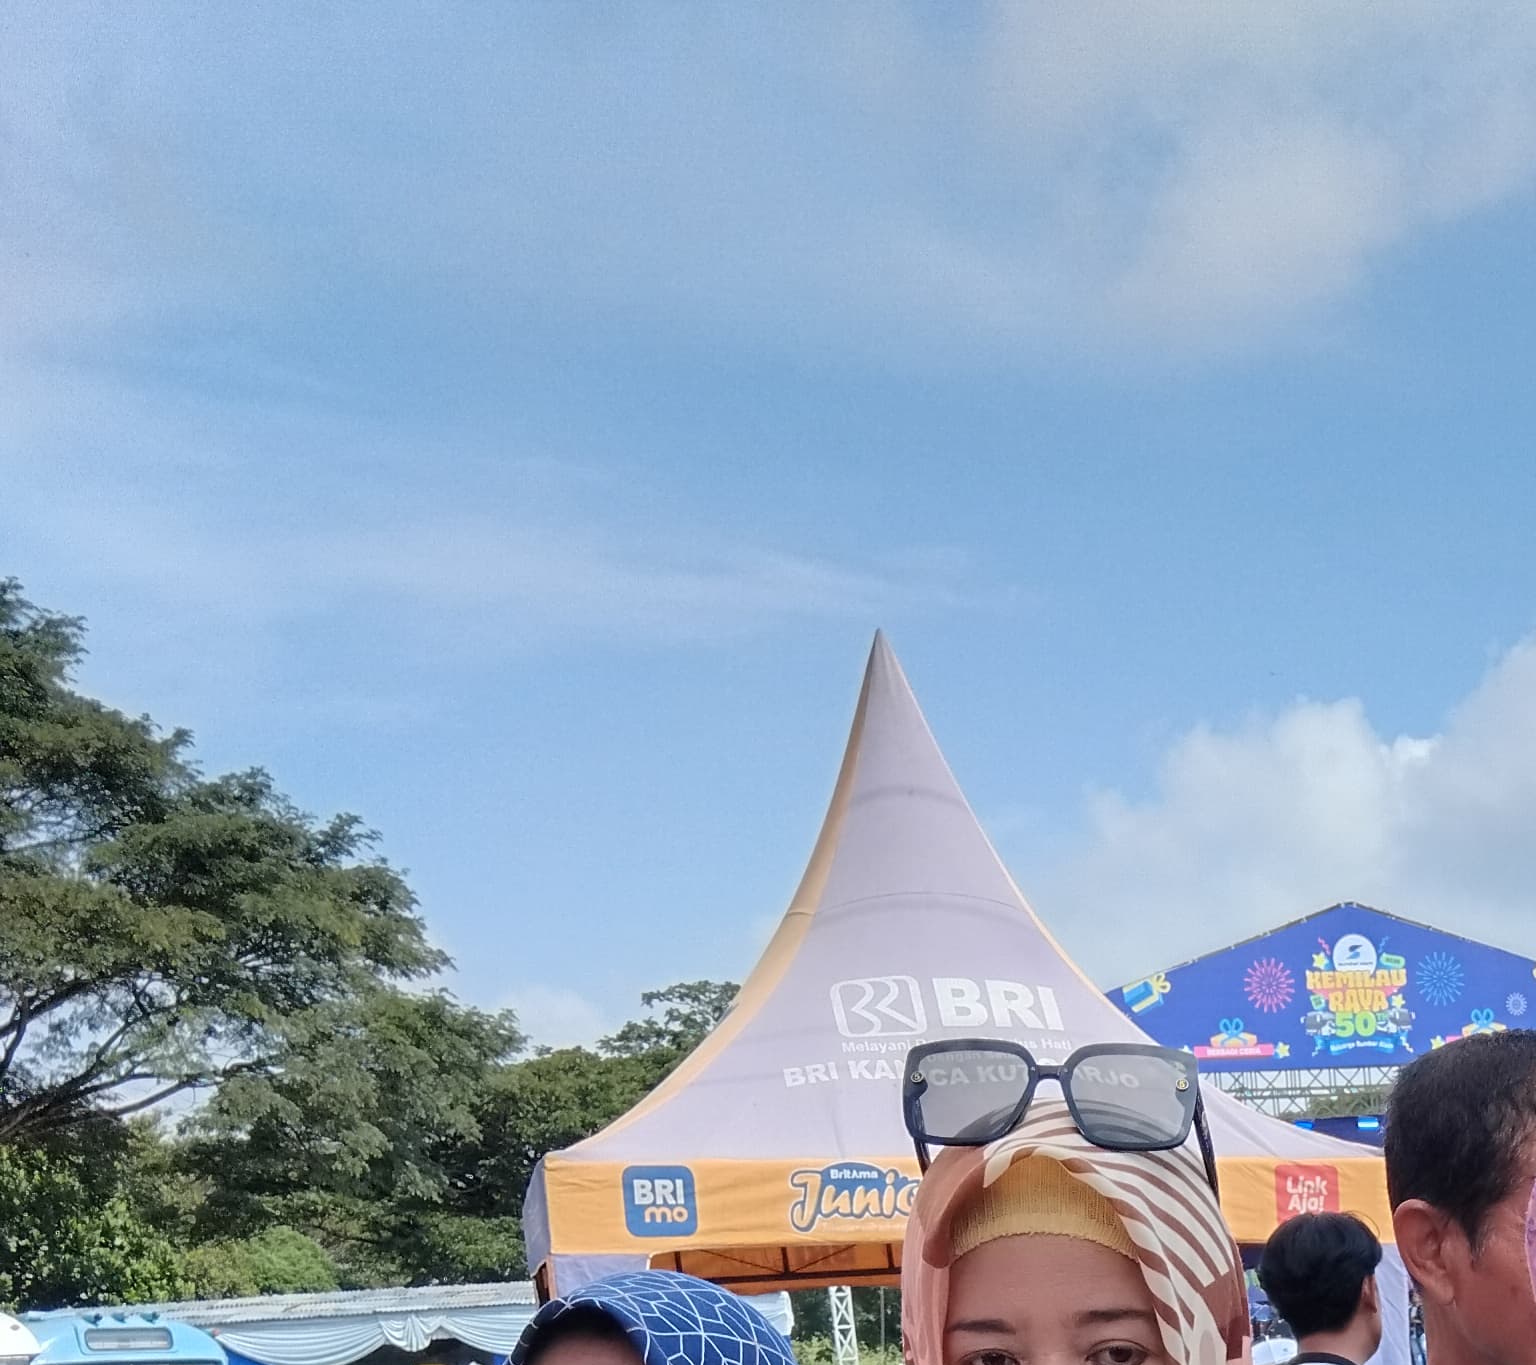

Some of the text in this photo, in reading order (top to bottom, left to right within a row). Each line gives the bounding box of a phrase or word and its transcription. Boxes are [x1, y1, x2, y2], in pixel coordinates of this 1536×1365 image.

[932, 977, 1065, 1031] BRI
[1335, 1011, 1376, 1037] 50
[841, 1039, 908, 1054] Melayani
[1039, 1038, 1072, 1051] Hati
[783, 1062, 838, 1088] BRI
[830, 1168, 879, 1180] BritAma
[1286, 1175, 1328, 1196] Link
[633, 1178, 686, 1206] BRI
[791, 1169, 922, 1232] Junio
[645, 1206, 688, 1224] mo
